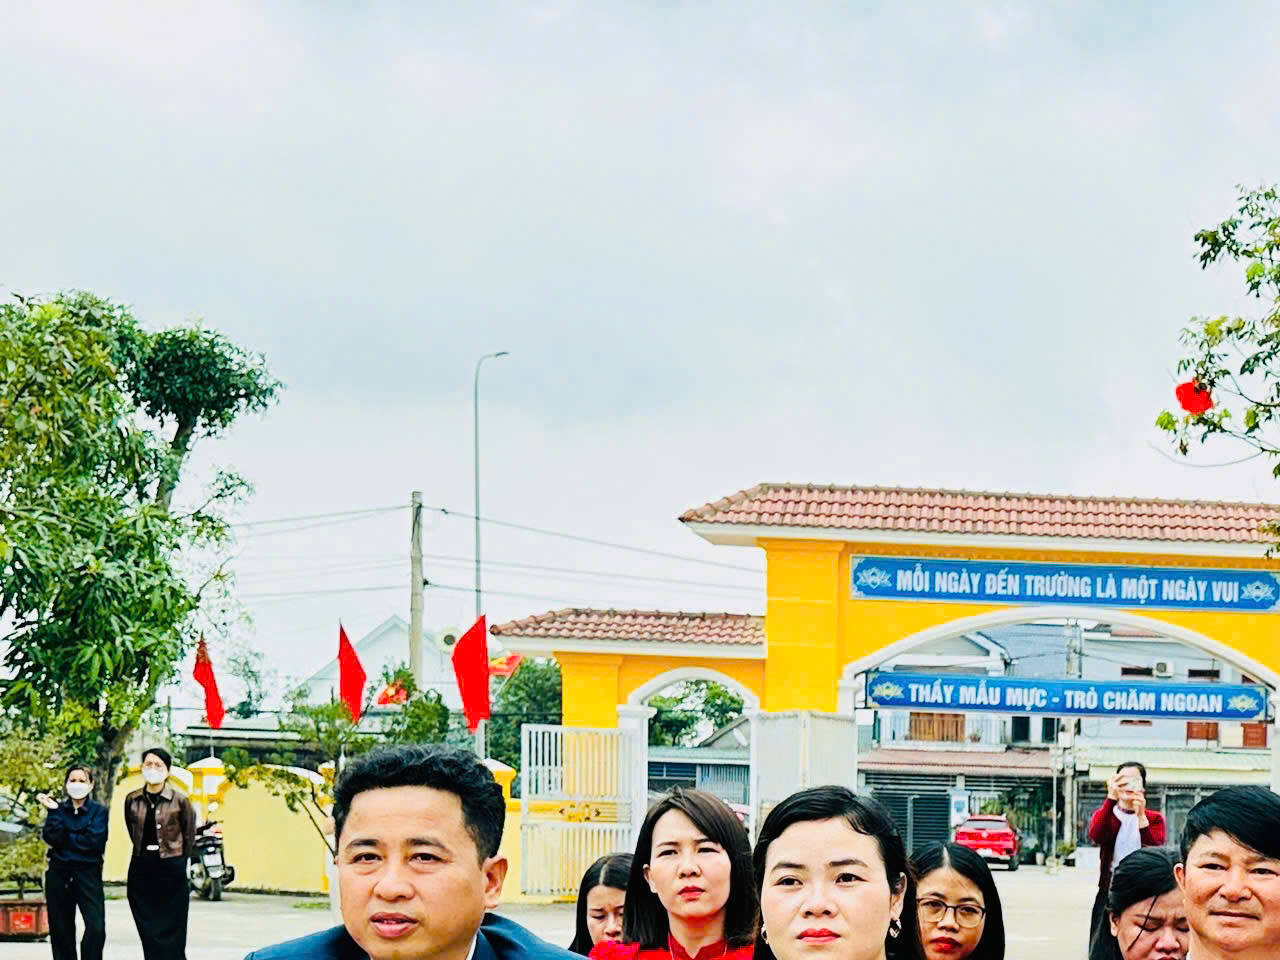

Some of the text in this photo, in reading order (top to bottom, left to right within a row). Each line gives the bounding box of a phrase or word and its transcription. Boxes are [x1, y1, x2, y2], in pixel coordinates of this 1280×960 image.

[934, 568, 981, 594] NGÀY
[985, 567, 1020, 596] ĐẾN
[1024, 571, 1092, 598] TRƯỜNG
[1096, 573, 1118, 599] LÀ
[1121, 574, 1159, 604] MỘT
[1162, 576, 1208, 601] NGÀY
[1211, 581, 1239, 603] VUI
[1005, 687, 1048, 711] MỰC
[1063, 686, 1098, 709] TRÒ
[1103, 688, 1156, 711] CHĂM
[1160, 692, 1223, 713] NGOAN
